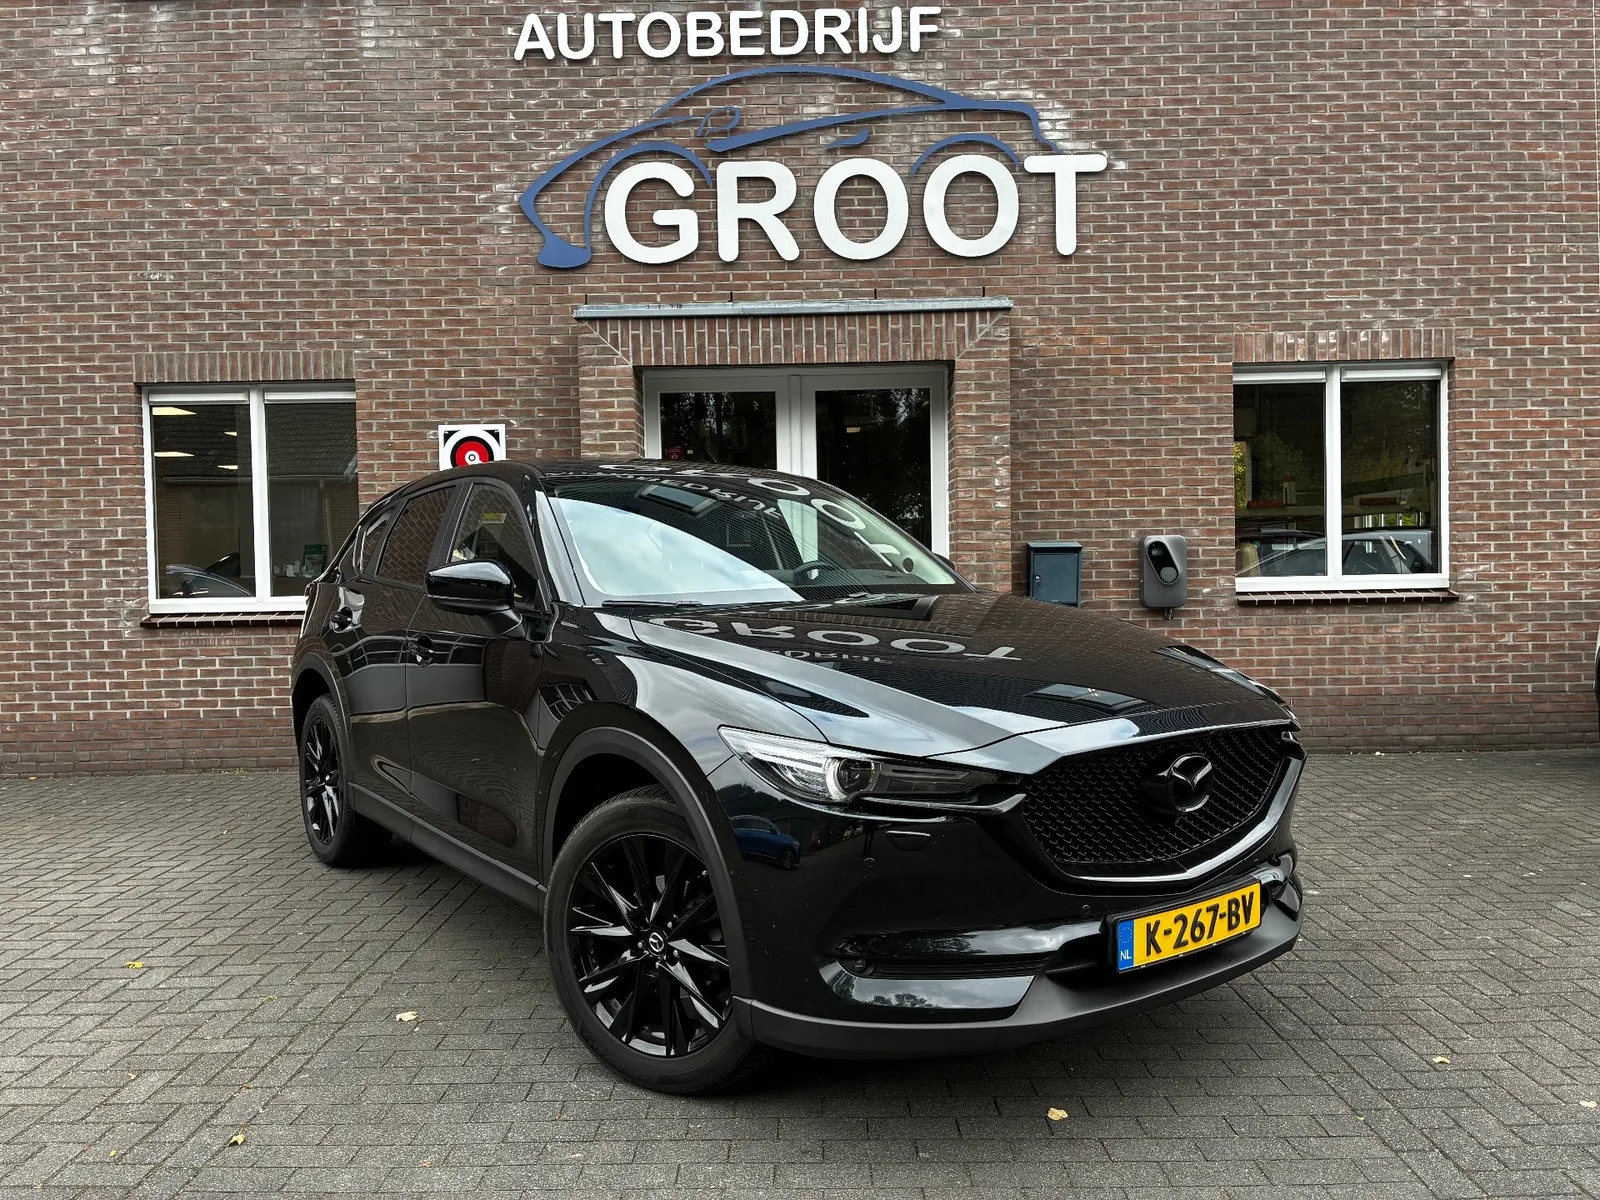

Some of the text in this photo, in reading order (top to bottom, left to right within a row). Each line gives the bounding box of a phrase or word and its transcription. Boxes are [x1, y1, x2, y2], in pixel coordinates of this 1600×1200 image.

[513, 6, 941, 61] AUTOBEDRIJF
[604, 153, 1107, 264] GROOT
[1146, 891, 1254, 956] K-267-BV
[1120, 949, 1131, 961] NL
